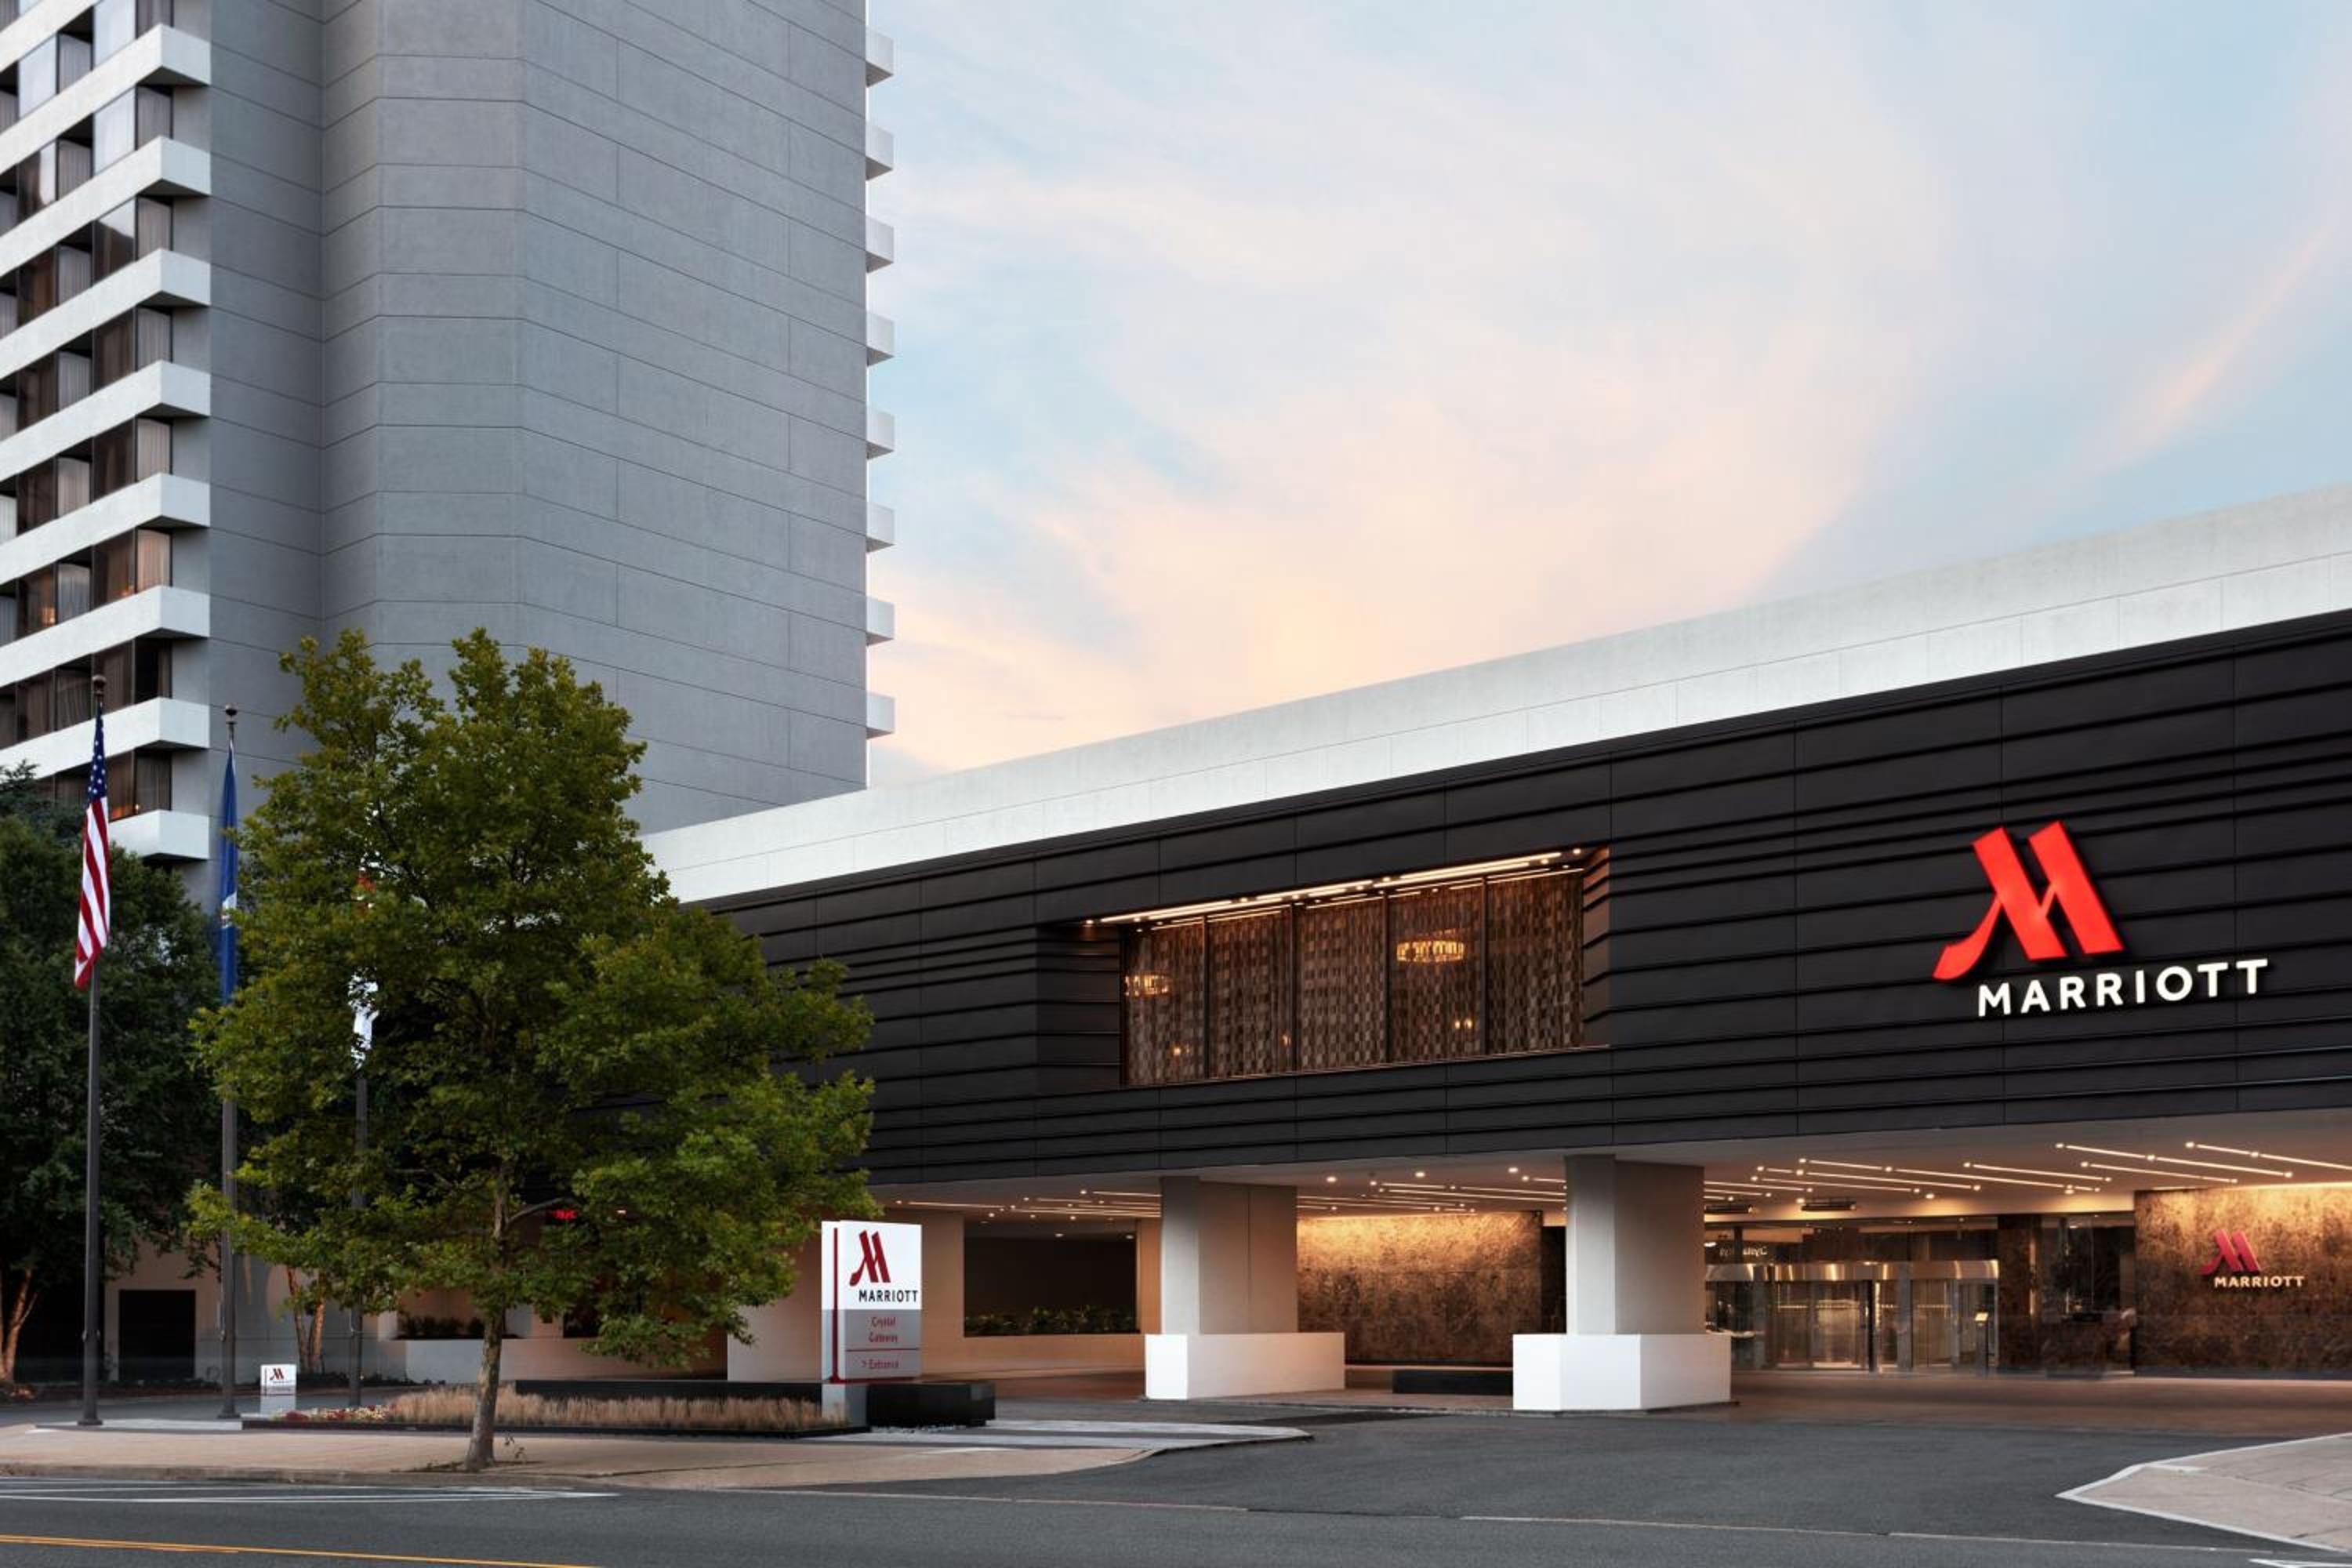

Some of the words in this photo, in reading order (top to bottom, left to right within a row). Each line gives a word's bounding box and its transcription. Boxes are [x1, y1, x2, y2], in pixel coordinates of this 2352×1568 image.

[1977, 958, 2269, 1018] MARRIOTT
[2214, 1275, 2305, 1289] MARRIOTT
[858, 1290, 918, 1303] MARRIOTT
